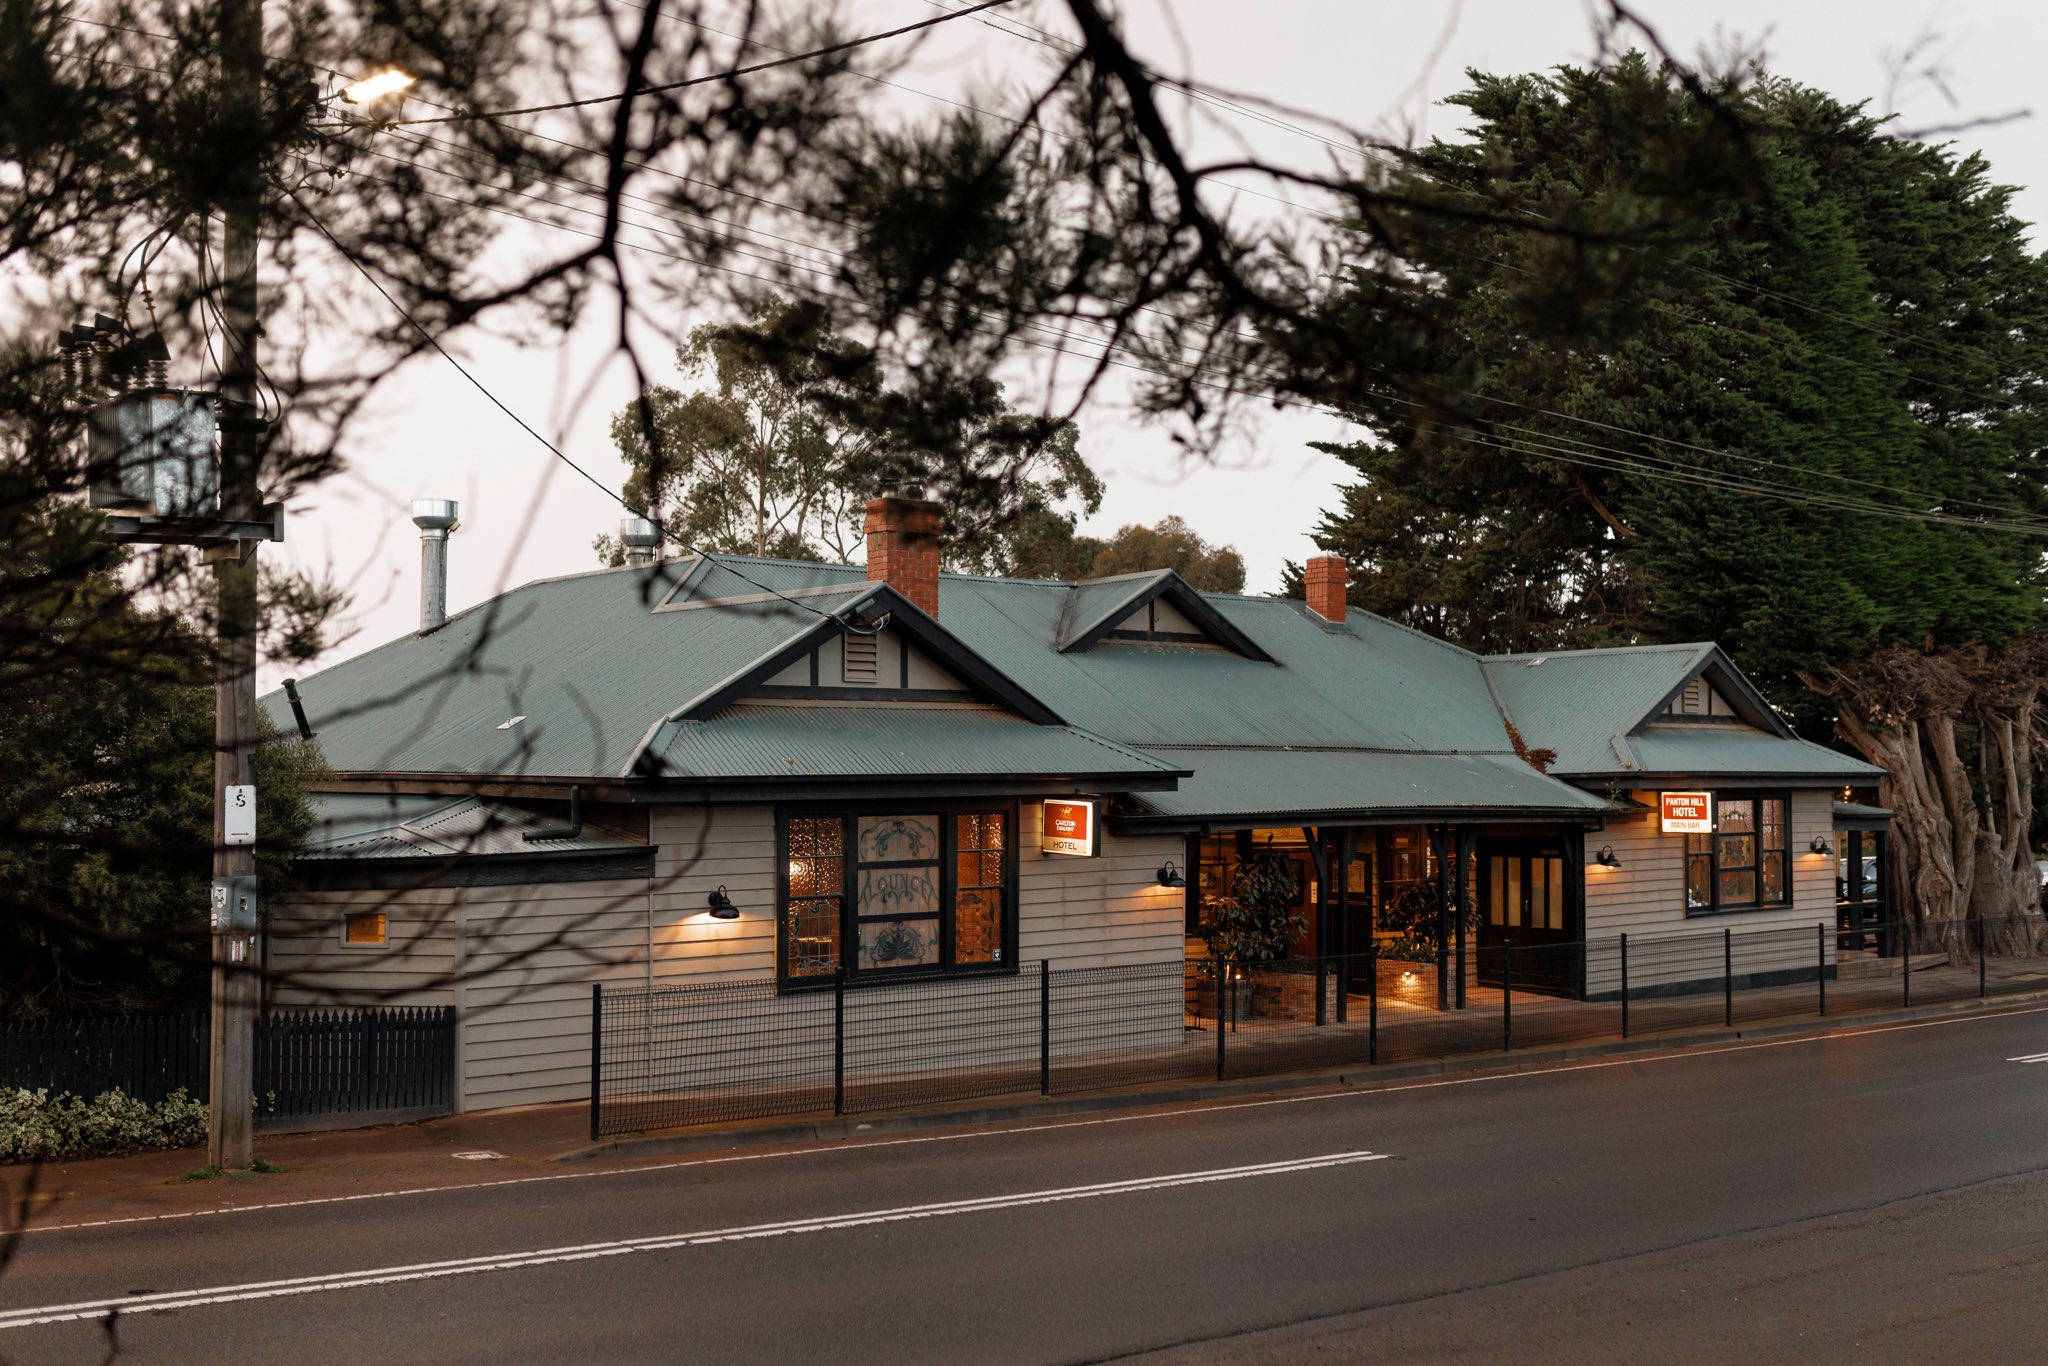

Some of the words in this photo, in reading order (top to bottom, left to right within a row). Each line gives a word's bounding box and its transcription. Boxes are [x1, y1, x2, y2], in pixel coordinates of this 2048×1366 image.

[1665, 797, 1690, 806] PANTON
[1690, 797, 1705, 807] HILL
[1672, 807, 1698, 817] HOTEL
[1671, 821, 1687, 829] MAIN
[1687, 821, 1700, 829] BAR
[1053, 840, 1077, 850] HOTEL
